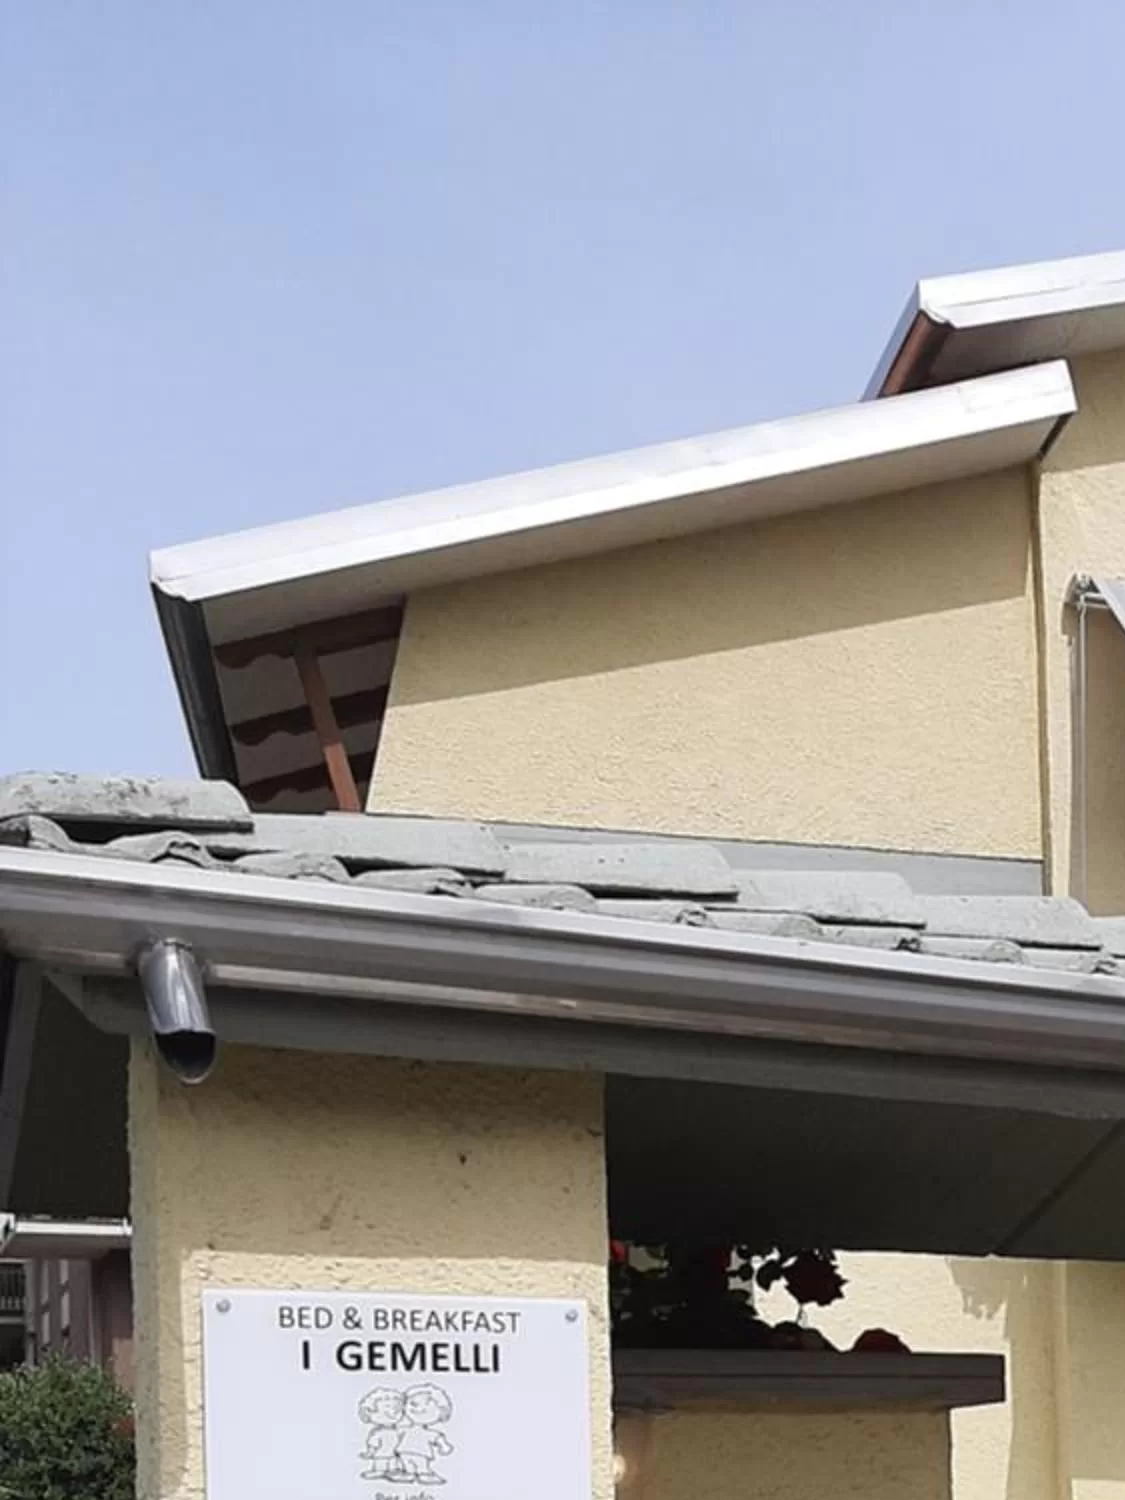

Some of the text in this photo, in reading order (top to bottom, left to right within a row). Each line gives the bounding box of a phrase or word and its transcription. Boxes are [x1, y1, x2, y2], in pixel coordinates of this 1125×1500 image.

[278, 1305, 521, 1334] BED & BREAKFAST
[302, 1339, 500, 1373] I GEMELLI
